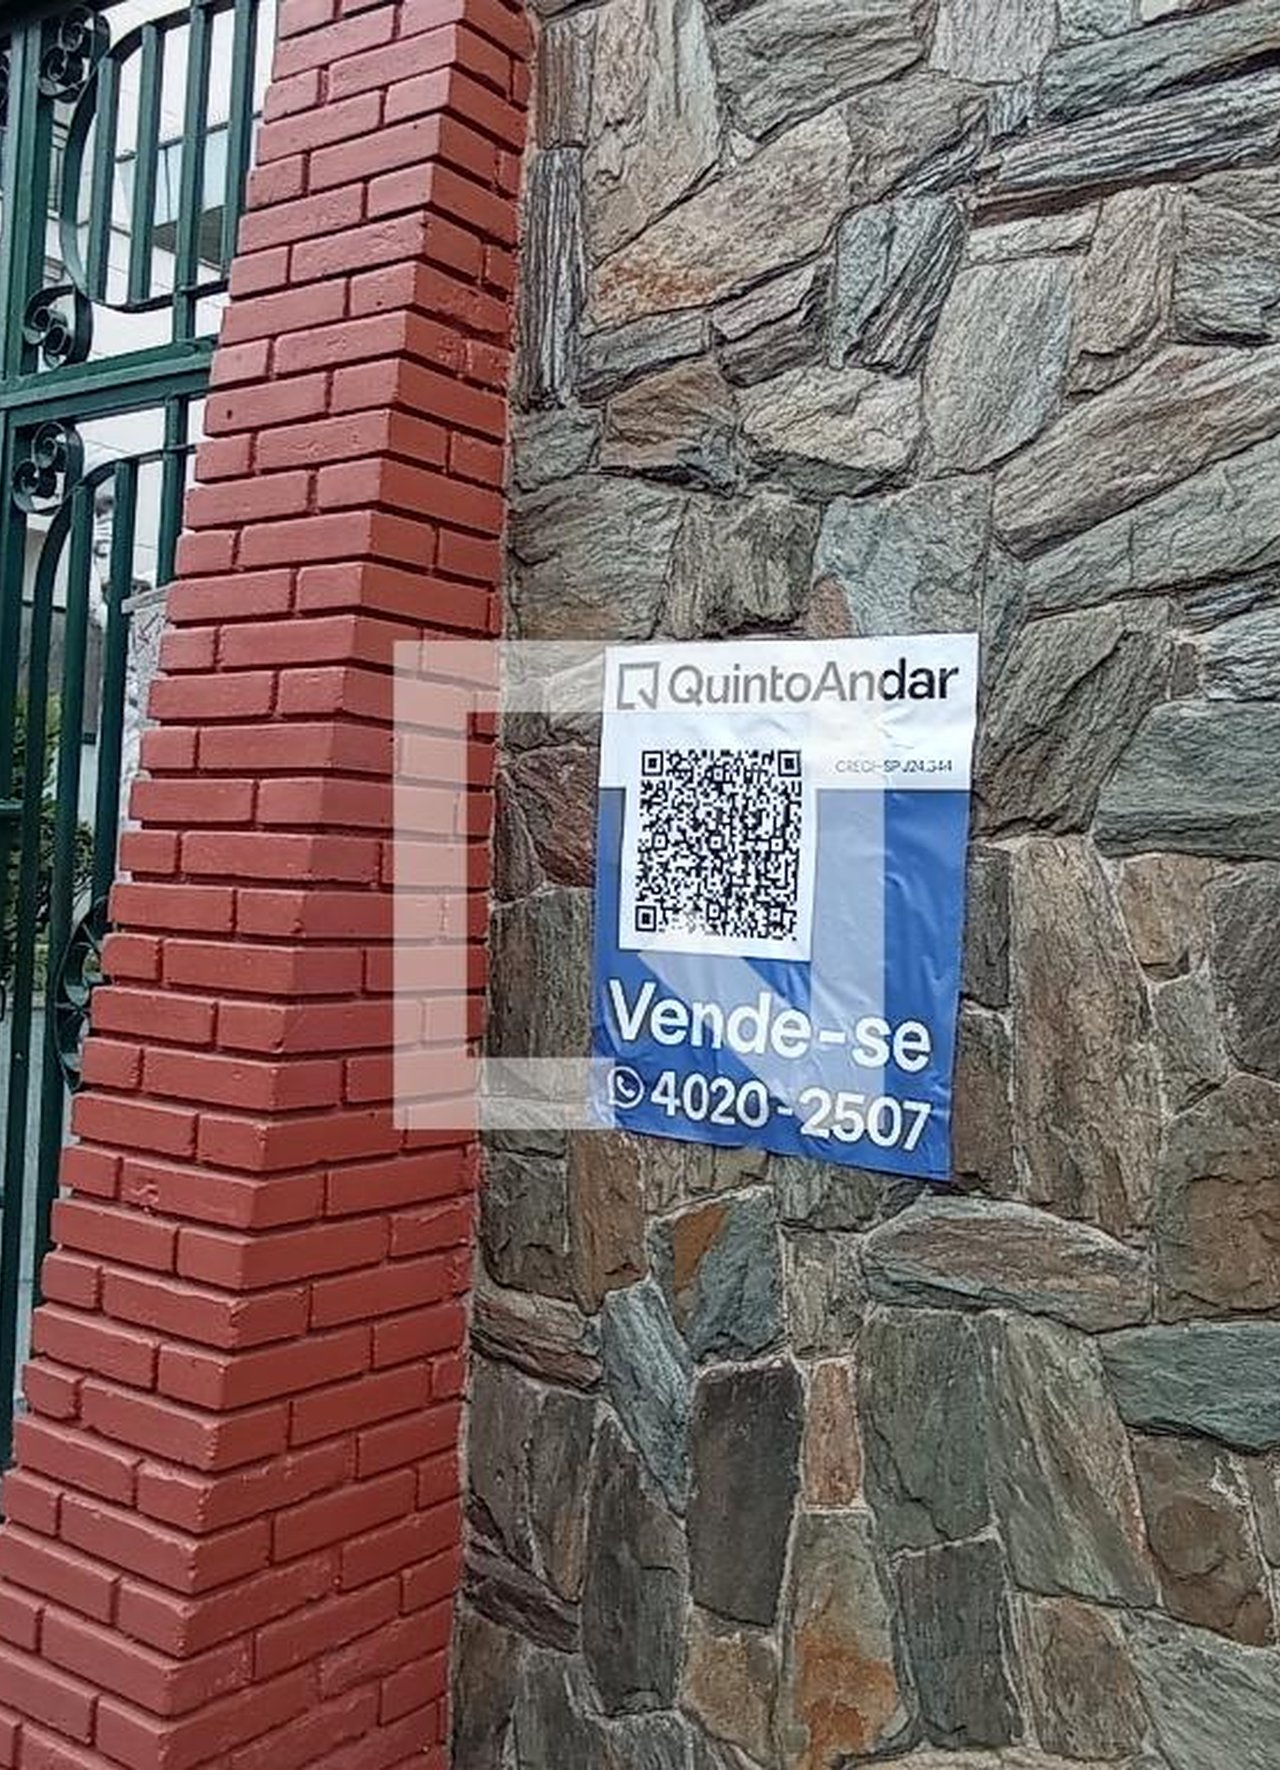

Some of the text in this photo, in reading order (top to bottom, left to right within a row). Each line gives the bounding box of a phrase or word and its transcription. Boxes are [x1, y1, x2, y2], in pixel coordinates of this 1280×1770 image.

[667, 657, 960, 708] QuintoAndar
[607, 979, 932, 1073] Vende-se
[650, 1070, 933, 1153] 4020-2507
